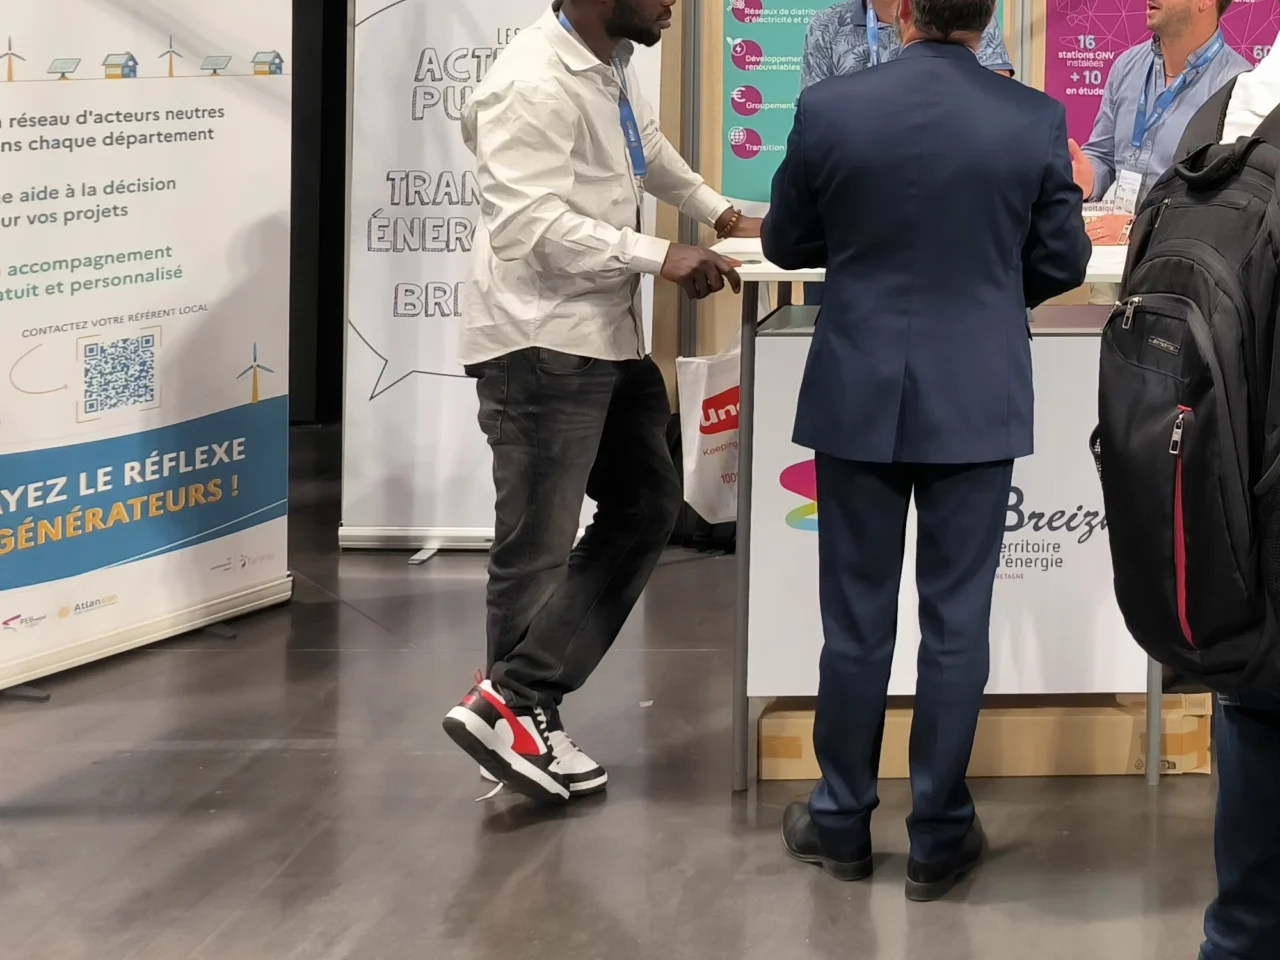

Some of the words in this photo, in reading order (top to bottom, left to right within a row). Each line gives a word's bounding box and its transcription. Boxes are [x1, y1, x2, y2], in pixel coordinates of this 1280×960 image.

[744, 7, 778, 15] Réseaux
[778, 8, 789, 16] de
[744, 15, 793, 24] d'électricité
[793, 16, 802, 24] et
[1057, 50, 1095, 59] stations
[1095, 51, 1115, 60] GNV
[1077, 34, 1096, 50] 16
[413, 47, 505, 83] ACT
[1069, 71, 1080, 82] +
[1083, 70, 1102, 85] 10
[411, 85, 474, 121] PU
[9, 112, 70, 129] réseau
[76, 109, 160, 126] d'acteurs
[165, 105, 225, 122] neutres
[0, 140, 22, 153] ns
[28, 135, 97, 153] chaque
[102, 127, 215, 150] département
[744, 143, 785, 151] Transition
[19, 185, 59, 203] aide
[65, 183, 75, 199] à
[81, 182, 97, 198] la
[102, 176, 177, 196] décision
[386, 170, 481, 207] TRAN
[0, 215, 21, 228] ur
[26, 211, 58, 225] vos
[63, 202, 129, 227] projets
[367, 207, 477, 253] ÉNER
[7, 245, 173, 277] accompagnement
[45, 281, 64, 295] et
[70, 264, 183, 296] personnalisé
[21, 320, 89, 339] CONTACTEZ
[91, 314, 125, 328] VOTRE
[128, 306, 176, 323] RÉFÉRENT
[179, 303, 209, 315] LOCAL
[703, 440, 739, 457] Keeping
[79, 465, 114, 497] LE
[123, 436, 246, 487] RÉFLEXE
[721, 471, 738, 485] 100
[0, 478, 223, 556] GÉNÉRATEURS
[231, 474, 239, 497] !
[1004, 485, 1108, 544] Breiz
[1000, 539, 1061, 554] erritoire
[997, 553, 1063, 572] 'énergie
